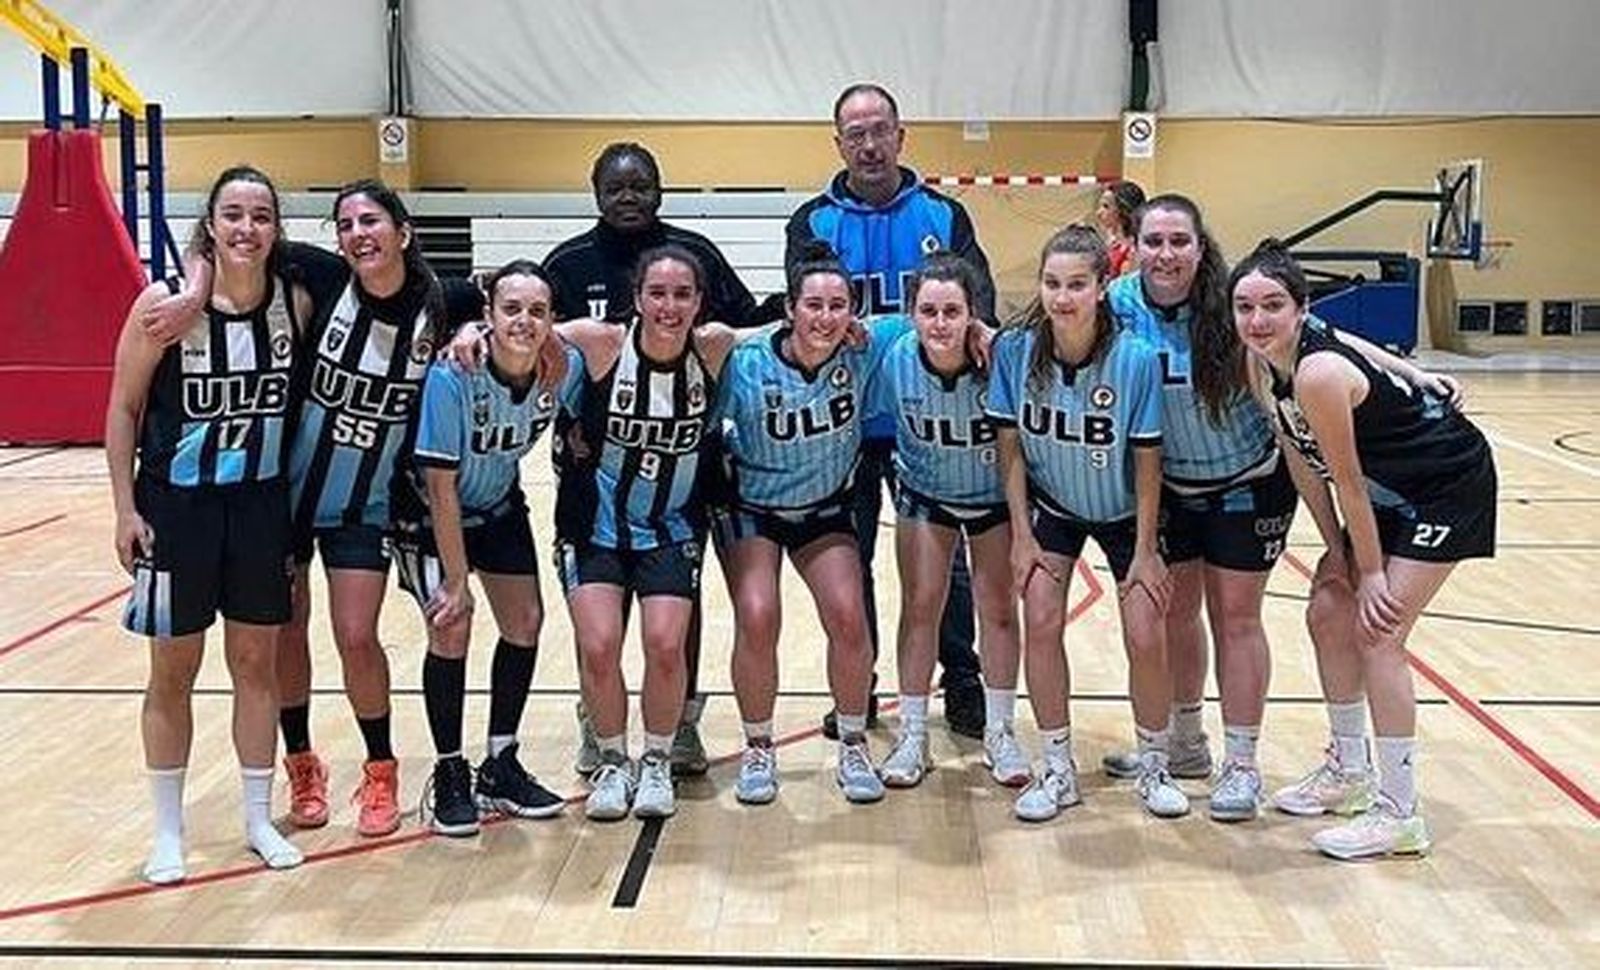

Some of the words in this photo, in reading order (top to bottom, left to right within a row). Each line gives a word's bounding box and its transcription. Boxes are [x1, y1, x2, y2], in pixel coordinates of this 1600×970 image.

[182, 372, 289, 419] ULB
[311, 360, 420, 421] ULB
[333, 416, 378, 449] 55
[765, 391, 857, 440] ULB
[902, 414, 997, 449] ULB
[1020, 400, 1118, 446] ULB
[218, 418, 252, 449] 17
[607, 415, 703, 455] ULB
[640, 451, 659, 480] 9
[1091, 449, 1109, 469] 9
[1411, 523, 1451, 548] 27
